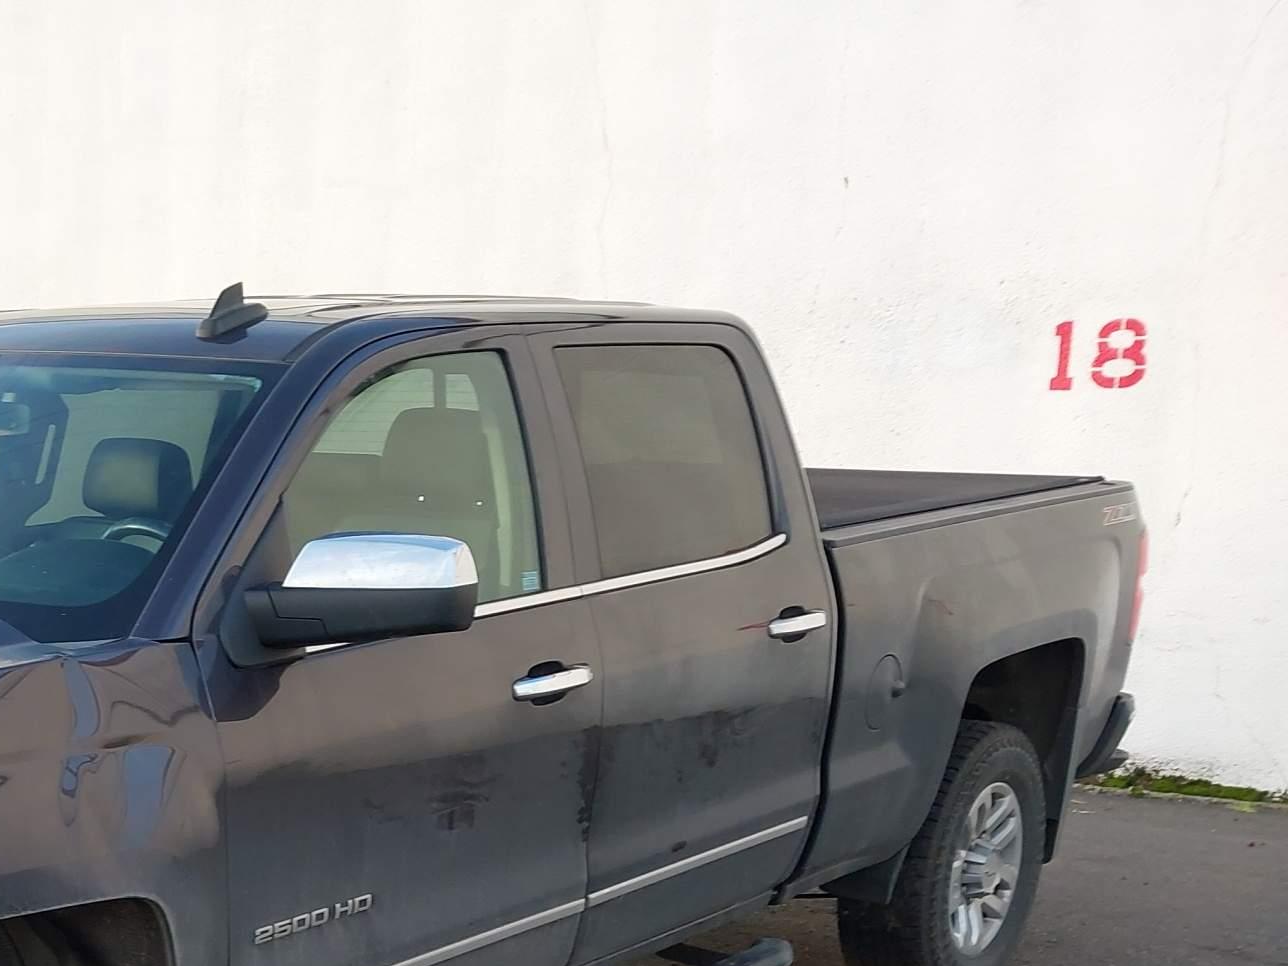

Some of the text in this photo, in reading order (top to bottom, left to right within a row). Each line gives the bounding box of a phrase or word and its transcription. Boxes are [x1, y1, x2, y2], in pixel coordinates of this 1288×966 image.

[1049, 318, 1146, 390] 18
[254, 893, 372, 944] 2500 HD
